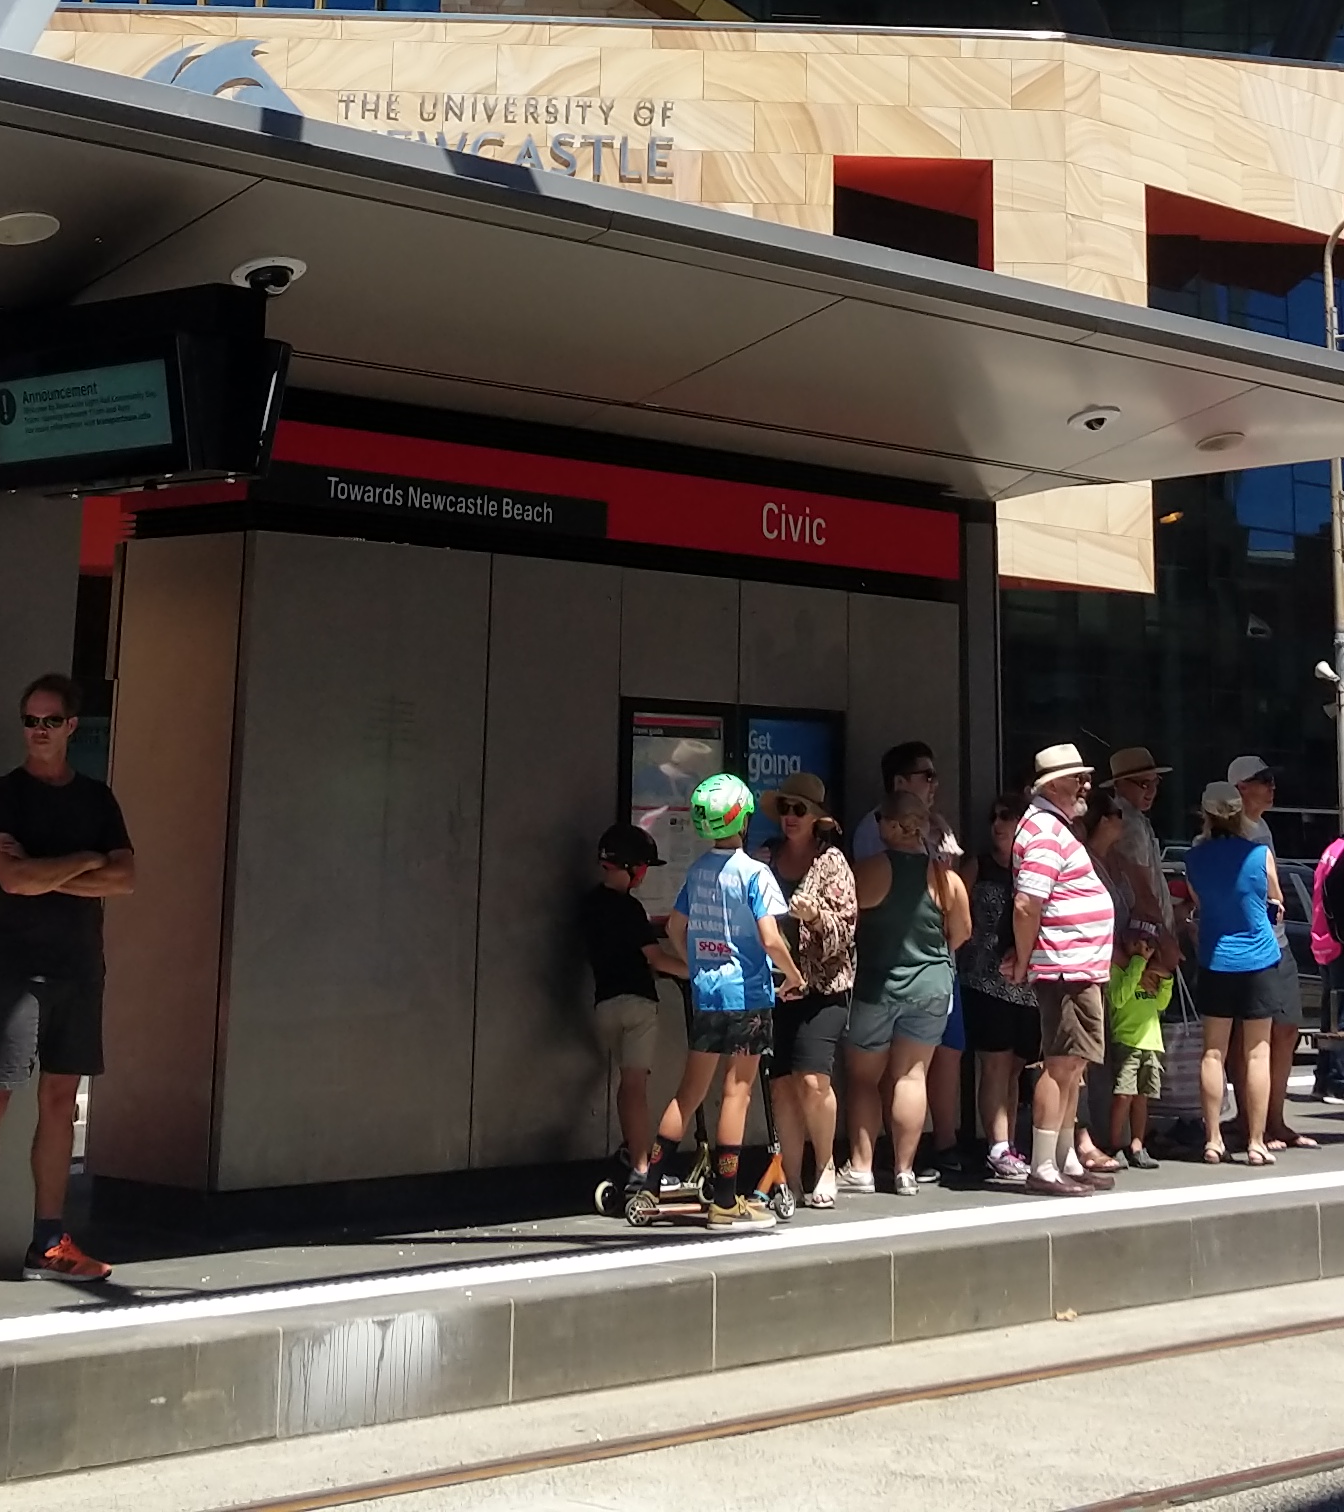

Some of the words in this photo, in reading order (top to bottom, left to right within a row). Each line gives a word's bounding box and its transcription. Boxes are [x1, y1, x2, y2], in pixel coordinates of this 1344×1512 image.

[338, 92, 401, 122] THE
[418, 93, 616, 126] UNIVERSITY
[633, 99, 676, 128] OF
[372, 129, 676, 185] CASTLE
[22, 381, 98, 405] Announcement
[326, 476, 404, 507] Towards
[408, 486, 498, 518] Newcastle
[502, 495, 554, 525] Beach
[761, 501, 827, 547] Civic
[748, 729, 773, 750] Get
